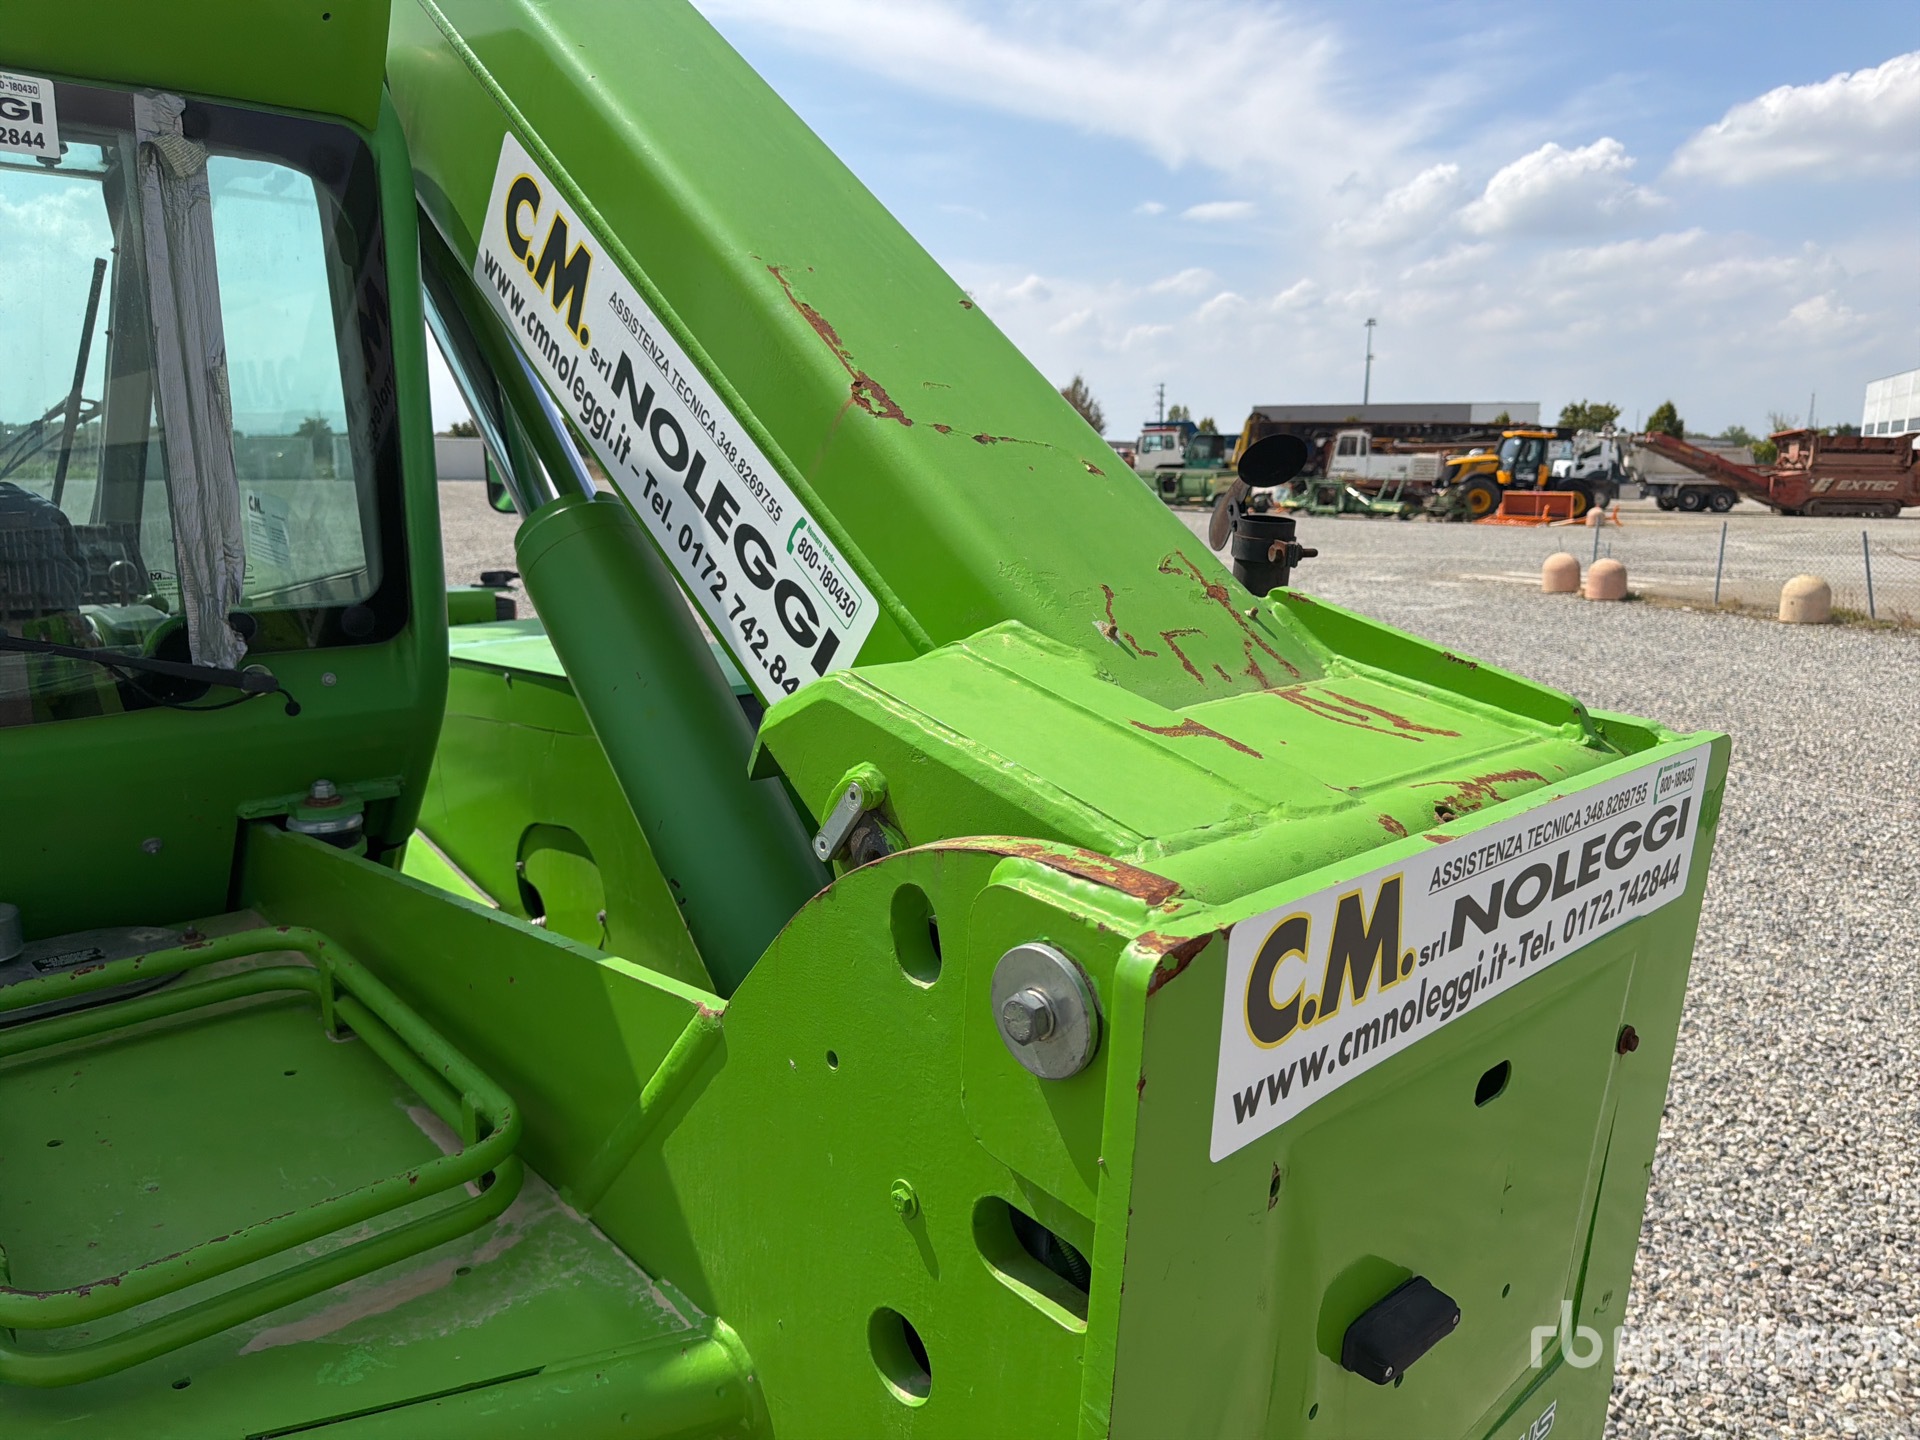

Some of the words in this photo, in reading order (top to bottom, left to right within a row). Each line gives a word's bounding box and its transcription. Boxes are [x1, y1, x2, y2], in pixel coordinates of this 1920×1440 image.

[504, 172, 592, 349] C.M.
[589, 347, 613, 383] srl
[610, 350, 841, 678] NOLEGGI
[609, 291, 670, 378] ASSISTENZA
[670, 367, 717, 439] TECNICA
[716, 431, 784, 522] 348.8269755
[1836, 478, 1899, 492] EXTEC
[678, 523, 728, 603] 0172
[797, 536, 856, 619] 800-180430
[1659, 765, 1695, 795] 800-180430
[1429, 832, 1523, 892] ASSISTENZA
[1527, 810, 1581, 847] TECNICA
[1583, 781, 1649, 826] 348.8269755
[1243, 871, 1417, 1049] C.M.
[1418, 930, 1447, 967] srl
[1448, 795, 1692, 953] NOLEGGI
[1562, 853, 1682, 944] 0172.742844
